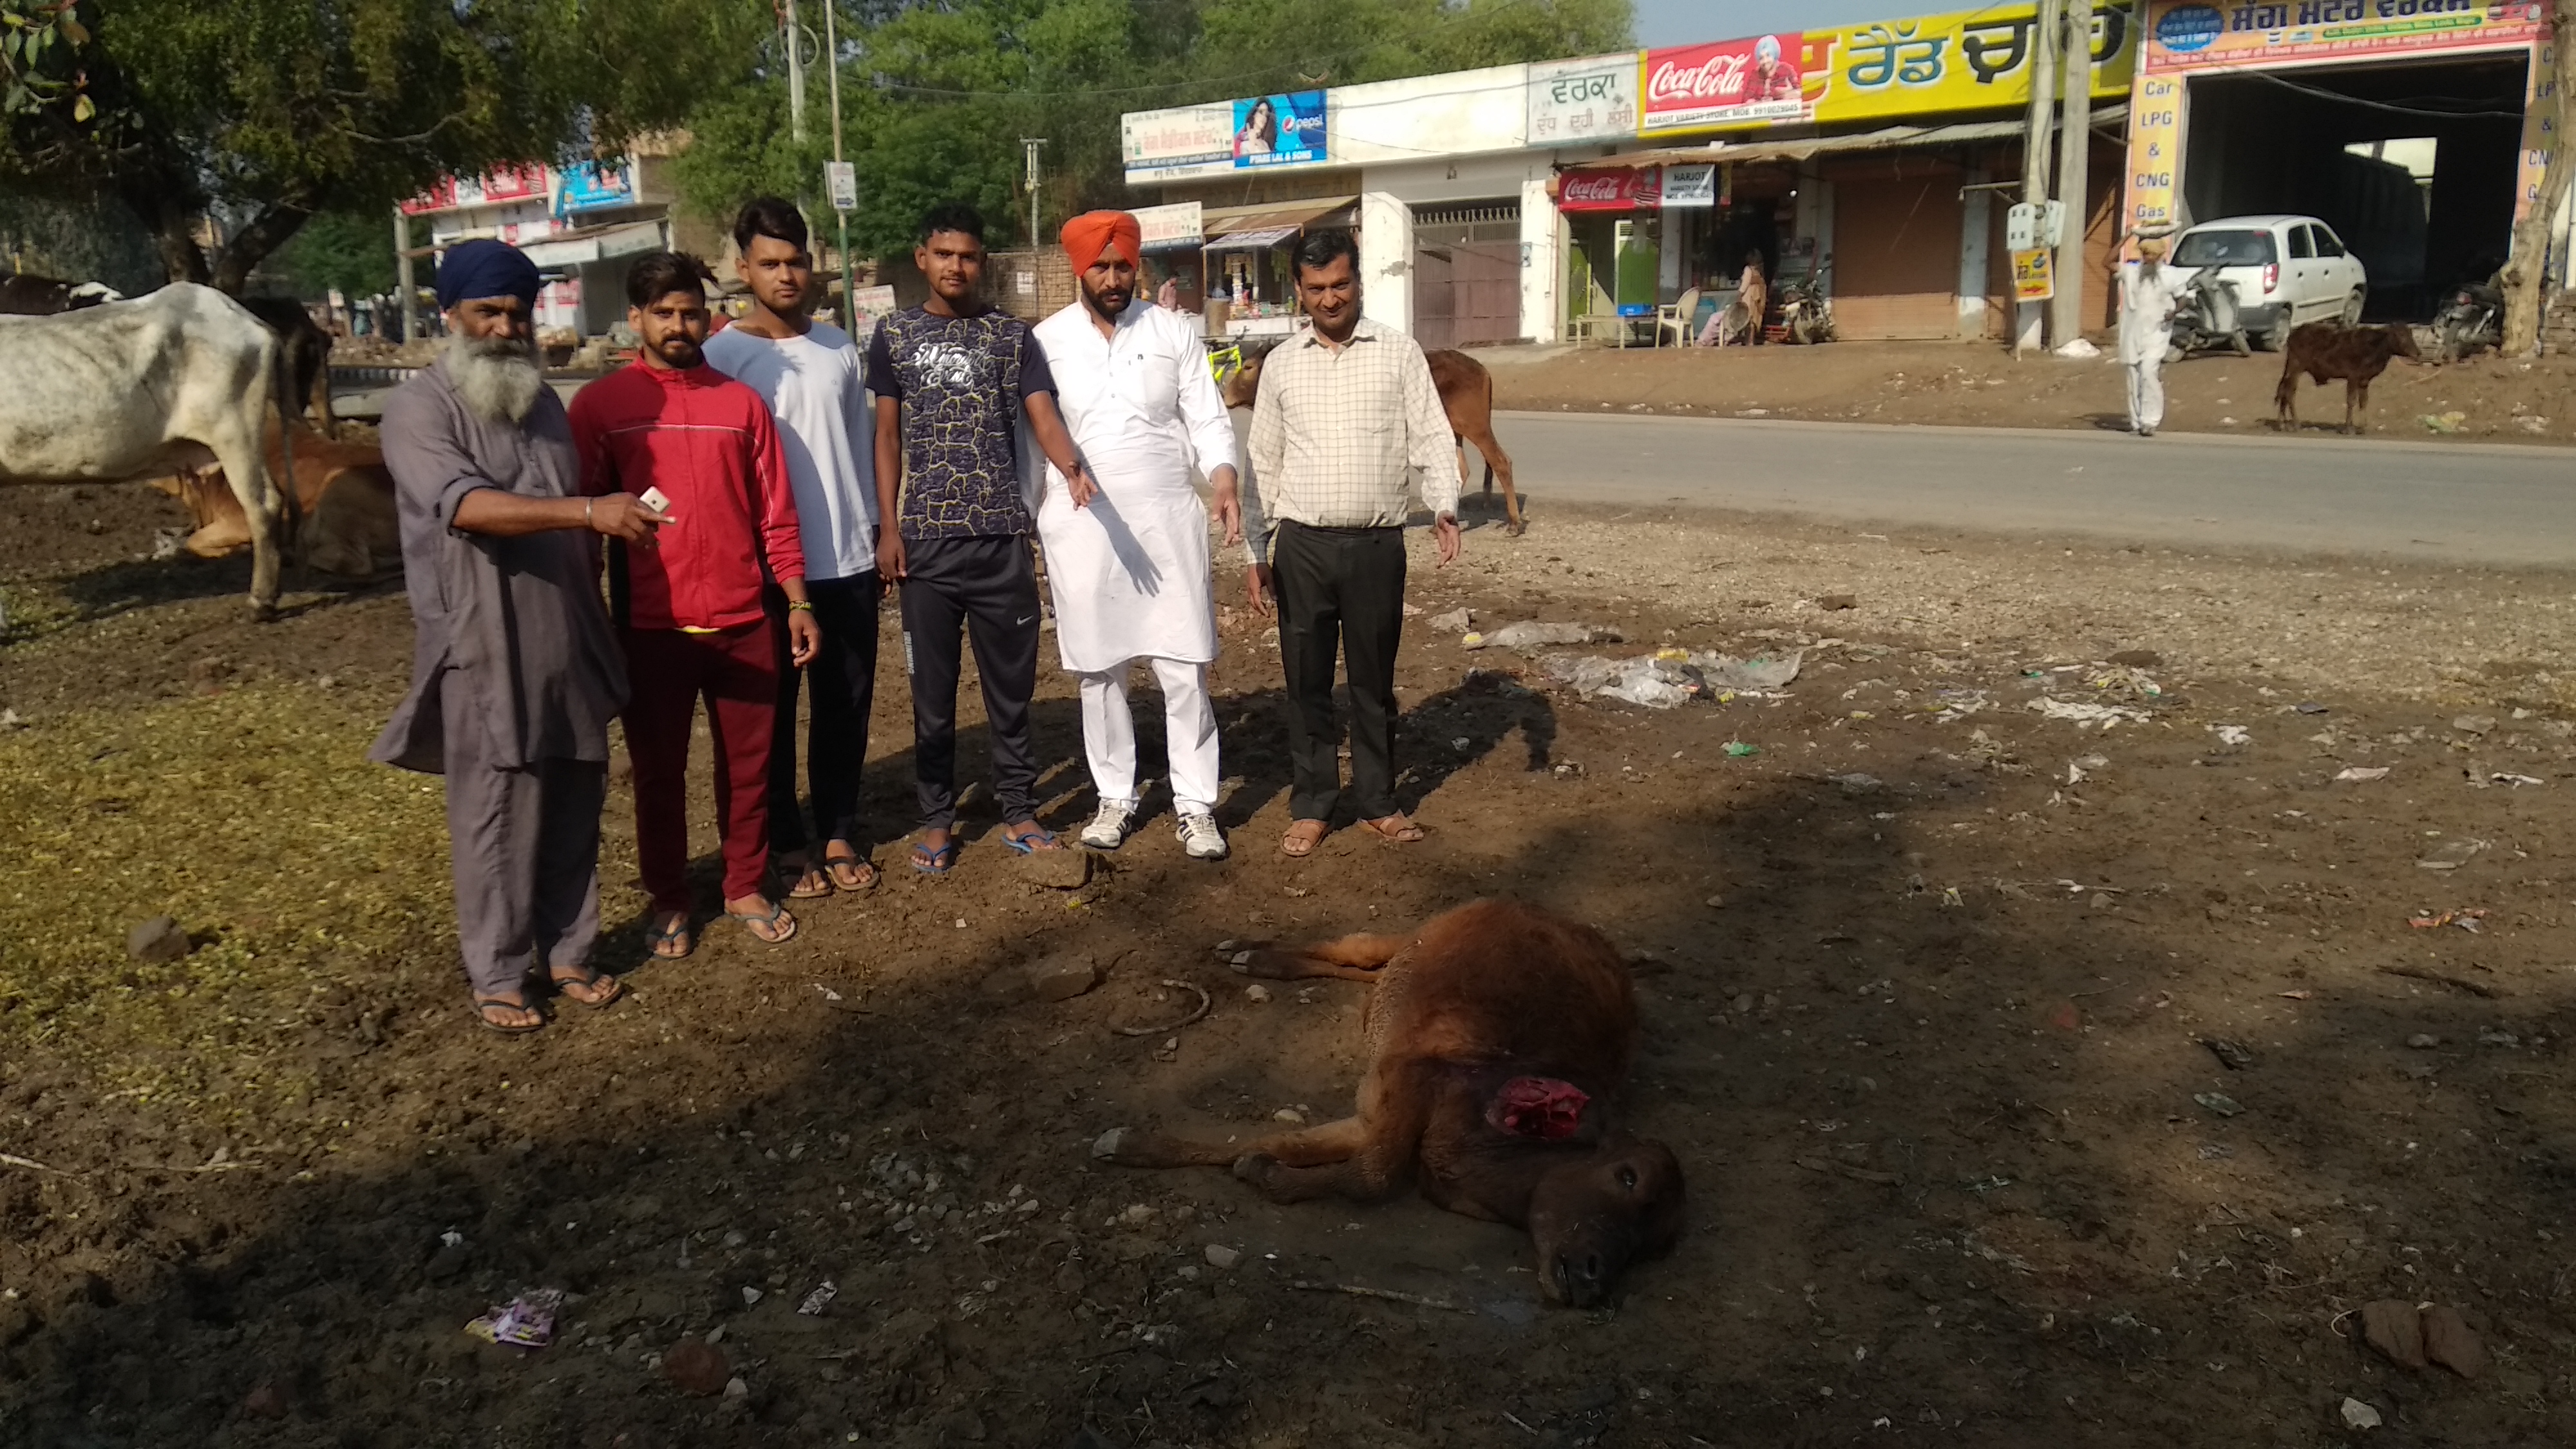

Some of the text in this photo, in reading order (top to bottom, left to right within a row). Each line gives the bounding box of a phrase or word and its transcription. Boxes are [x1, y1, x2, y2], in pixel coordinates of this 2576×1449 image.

[1648, 53, 1752, 102] Coca-Cola
[2145, 80, 2174, 96] Car
[2537, 81, 2555, 98] LP
[1295, 113, 1324, 131] pepsi
[2141, 111, 2173, 126] LPG
[2148, 141, 2161, 156] &
[2528, 149, 2553, 166] CN
[1674, 171, 1707, 182] HARJOT
[2136, 173, 2170, 188] CNG
[1565, 177, 1621, 202] Coca-Cola
[2136, 204, 2166, 218] Gas
